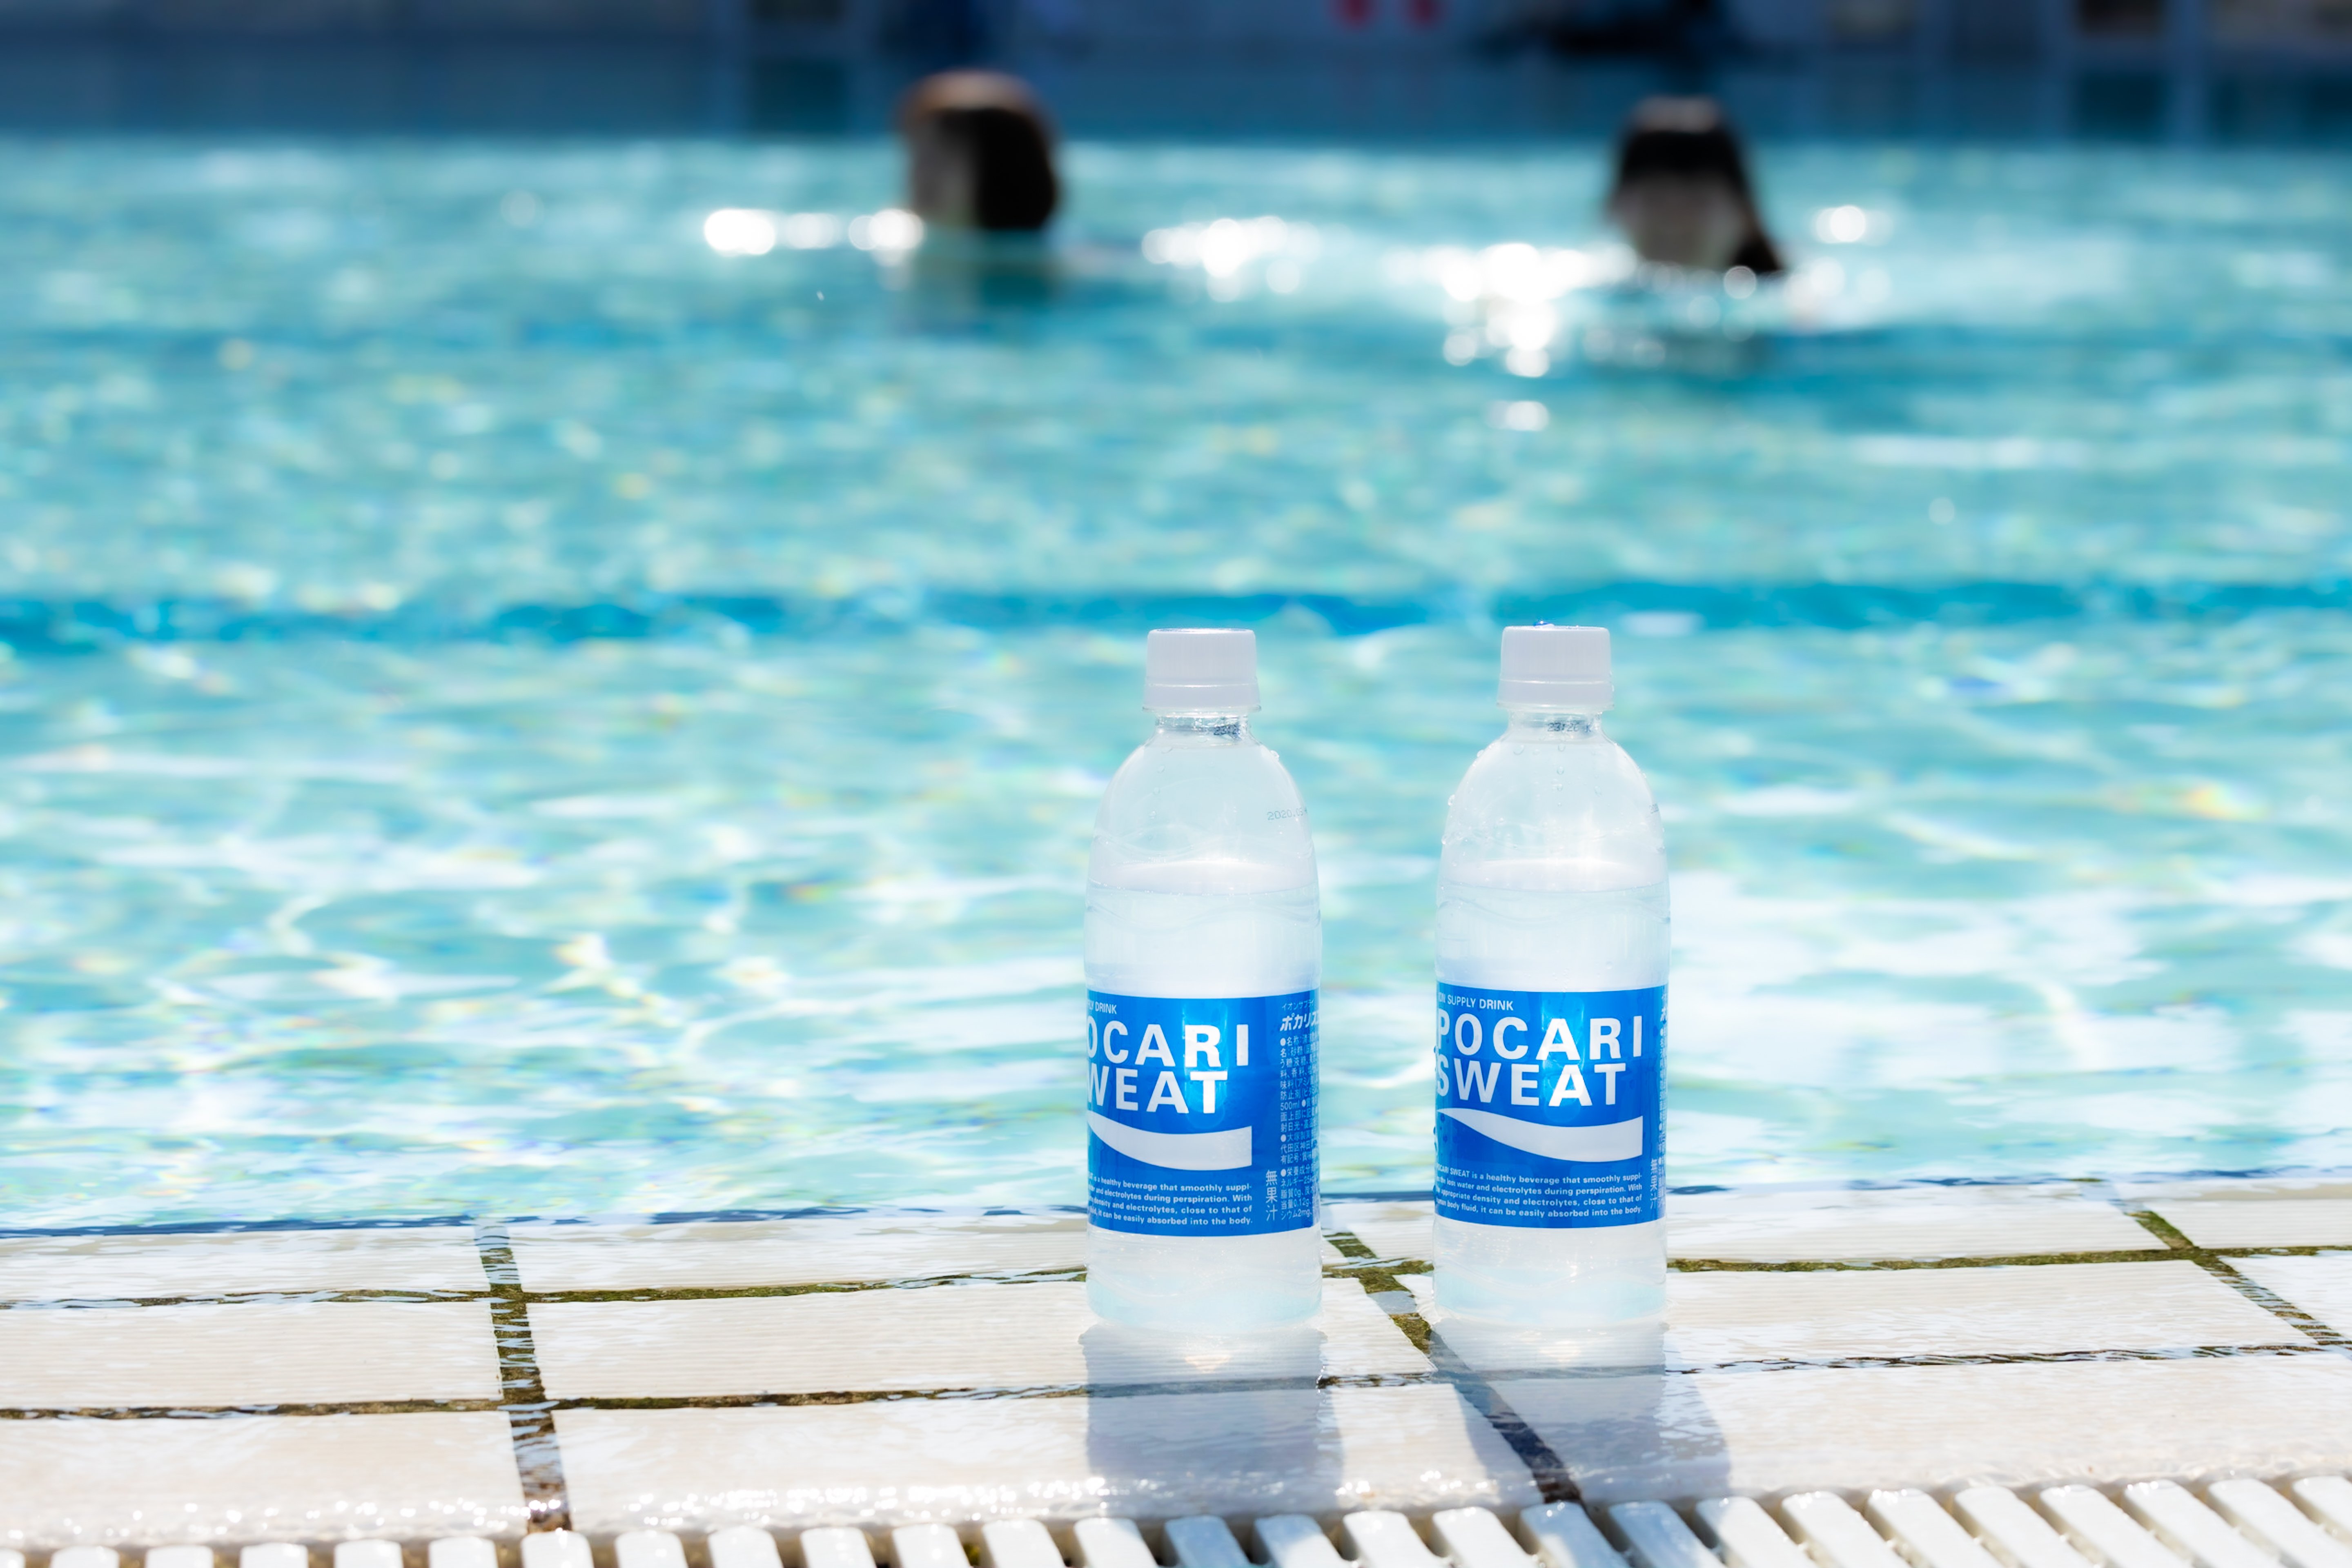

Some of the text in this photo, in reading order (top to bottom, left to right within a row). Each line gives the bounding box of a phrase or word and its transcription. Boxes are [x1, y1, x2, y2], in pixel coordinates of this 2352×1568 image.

[1095, 1001, 1117, 1014] DRINK
[1447, 994, 1476, 1008] SUPPLY
[1479, 999, 1514, 1011] DRINK
[1437, 1008, 1642, 1060] POCARI
[1437, 1054, 1626, 1106] SWEAT
[1280, 1099, 1300, 1111] 500ml
[1450, 1168, 1470, 1178] SWEAT
[1486, 1173, 1516, 1183] healthy
[1519, 1176, 1559, 1185] beverage
[1583, 1175, 1620, 1183] smoothly
[1623, 1172, 1642, 1181] suppl-
[1101, 1177, 1121, 1188] healthy
[1123, 1180, 1158, 1191] beverage
[1180, 1184, 1223, 1193] smoothly
[1225, 1183, 1252, 1192] suppl-
[1492, 1185, 1542, 1195] electrolytes
[1545, 1188, 1573, 1196] during
[1576, 1186, 1626, 1196] perspiration.
[1628, 1183, 1642, 1191] With
[1104, 1189, 1142, 1200] electrolytes
[1144, 1194, 1171, 1203] during
[1173, 1195, 1229, 1204] perspiration.
[1232, 1194, 1252, 1202] With
[1266, 1170, 1278, 1221] 無果汁
[1441, 1189, 1470, 1200] appropriate
[1472, 1194, 1501, 1204] density
[1523, 1198, 1579, 1207] electrolytes,
[1126, 1203, 1178, 1214] electrolytes,
[1243, 1205, 1252, 1213] of
[1447, 1200, 1460, 1211] body
[1461, 1203, 1478, 1213] fluid,
[1519, 1209, 1545, 1218] easily
[1625, 1205, 1642, 1214] body.
[1114, 1212, 1121, 1220] be
[1123, 1215, 1144, 1224] easily
[1147, 1216, 1187, 1225] absorbed
[1229, 1217, 1253, 1225] body.
